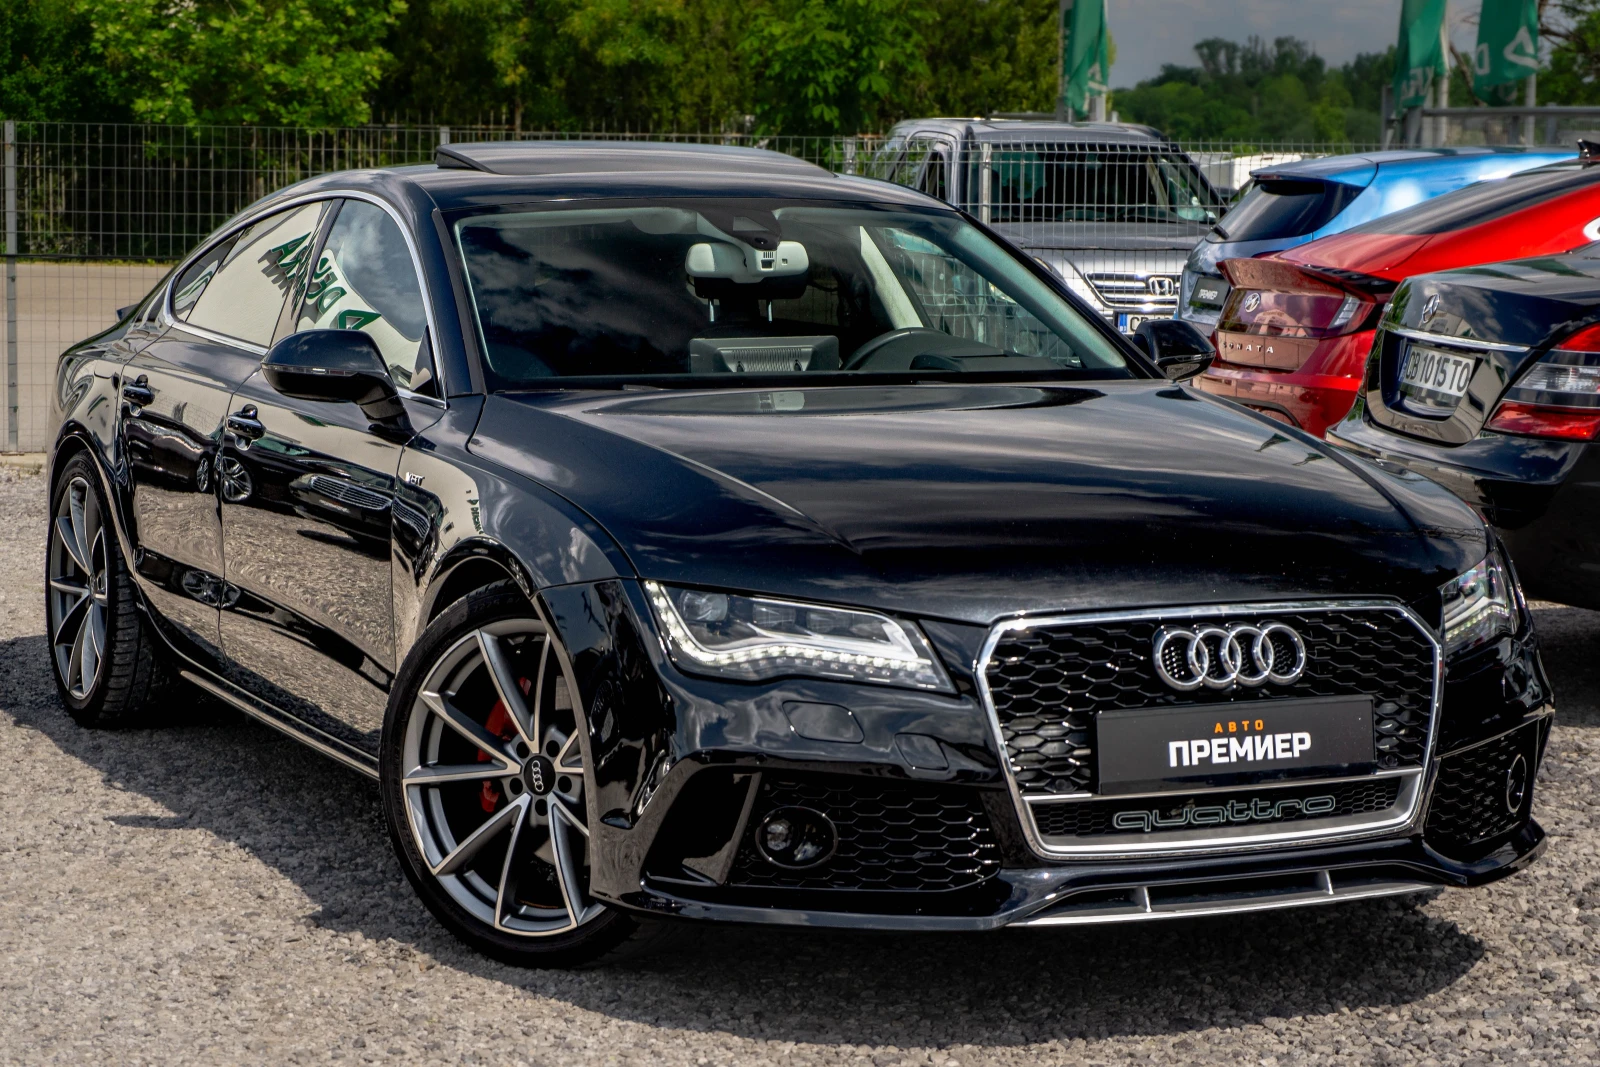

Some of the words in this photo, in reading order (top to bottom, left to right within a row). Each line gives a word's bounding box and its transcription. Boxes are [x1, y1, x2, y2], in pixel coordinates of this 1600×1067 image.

[1222, 341, 1274, 354] SONATA
[1405, 351, 1421, 380] CB
[1420, 353, 1450, 388] 1015
[1449, 359, 1471, 393] TO
[1214, 719, 1264, 733] АВТО
[1168, 731, 1312, 767] ПРЕМИЕР
[1112, 795, 1336, 832] quattro
